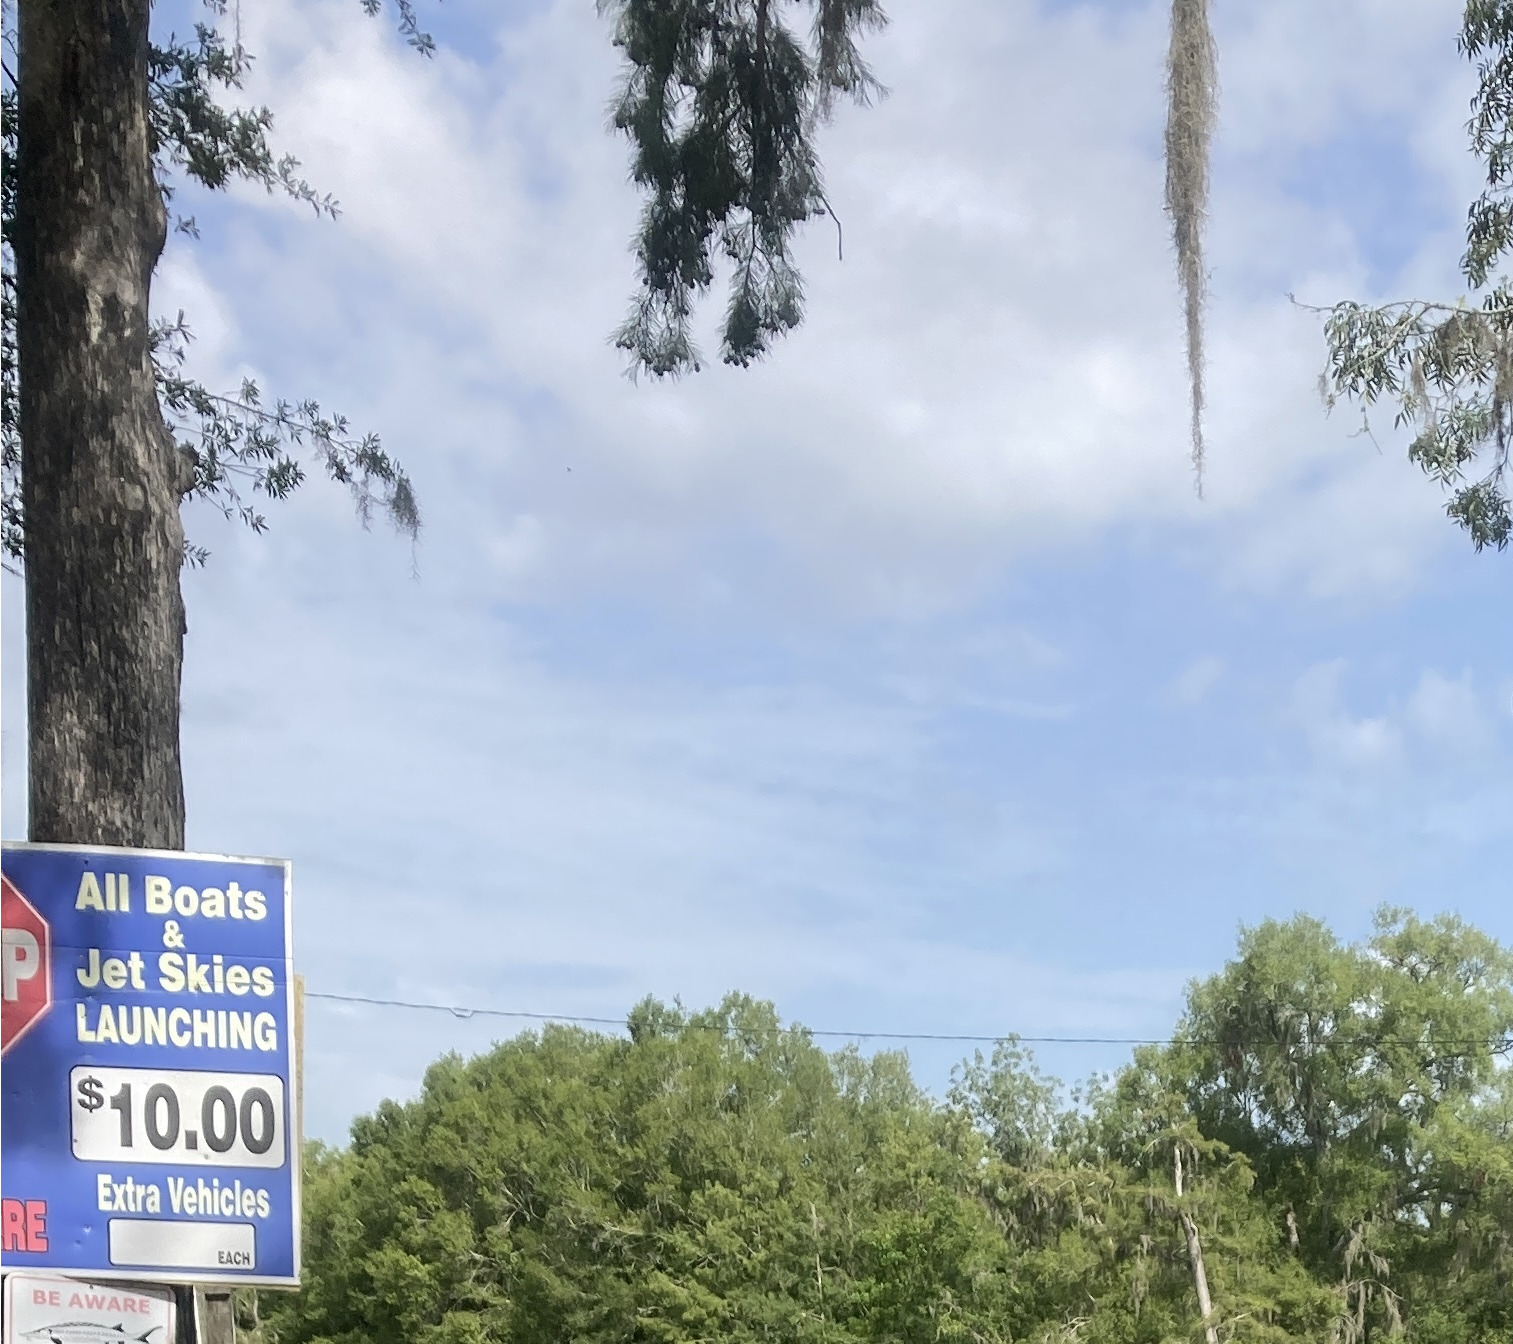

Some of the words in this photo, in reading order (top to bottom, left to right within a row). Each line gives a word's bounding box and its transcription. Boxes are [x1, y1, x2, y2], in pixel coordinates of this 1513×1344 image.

[75, 872, 129, 912] All
[145, 875, 267, 920] Boats
[163, 920, 185, 948] &
[77, 948, 145, 989] Jet
[158, 952, 274, 996] Skies
[76, 1003, 277, 1051] LAUNCHING
[77, 1075, 275, 1154] $10.00
[97, 1174, 160, 1213] Extra
[167, 1177, 270, 1218] Vehicles
[218, 1251, 251, 1265] EACH
[33, 1289, 60, 1306] BE
[68, 1293, 151, 1314] AWARE
